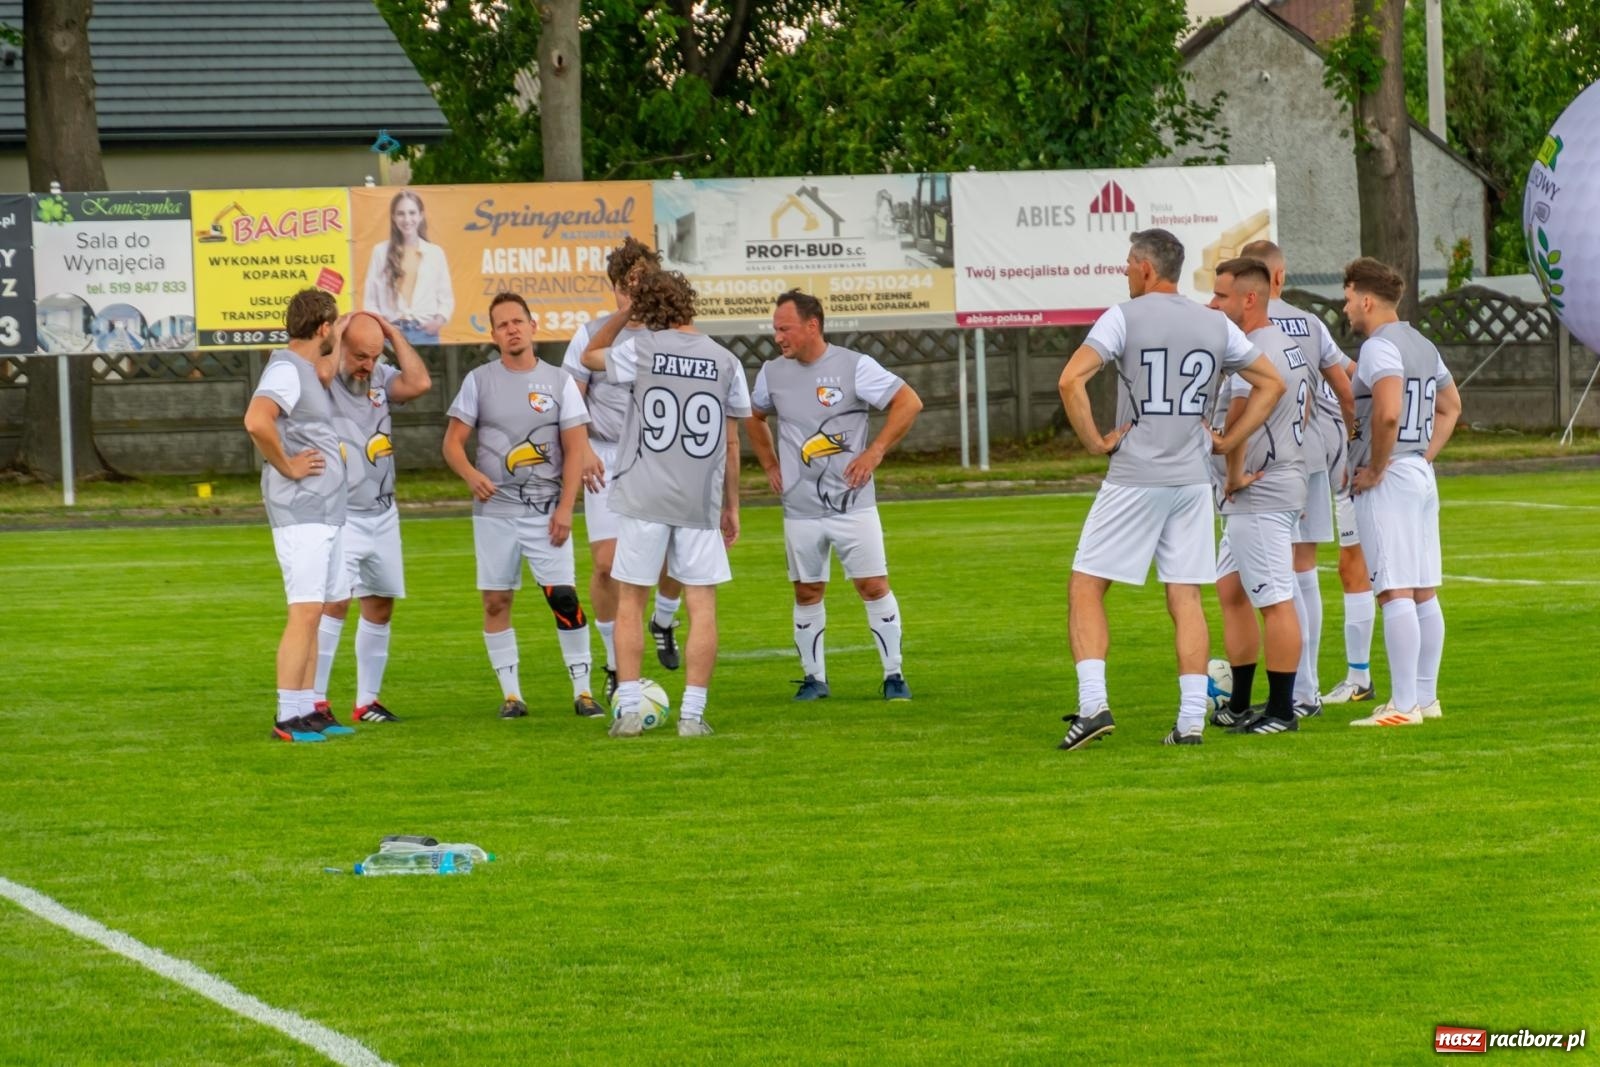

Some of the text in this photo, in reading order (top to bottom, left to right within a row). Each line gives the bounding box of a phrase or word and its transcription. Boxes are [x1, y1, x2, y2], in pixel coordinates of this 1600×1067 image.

[81, 197, 183, 219] Koniczynka
[1016, 204, 1076, 227] ABIES
[233, 207, 343, 242] BAGER
[464, 196, 634, 238] Springendal
[76, 232, 150, 249] Sala do
[746, 243, 843, 259] PROFI-BUD
[63, 254, 165, 275] Wynajęcia
[208, 254, 335, 267] WYKONAM USŁUGI
[481, 246, 610, 275] AGENCJA PRA
[243, 269, 308, 280] KOPARKĄ
[965, 263, 1129, 280] Twój specjalista od drew
[86, 281, 187, 295] tel. 519 847 833
[482, 275, 616, 296] ZAGRANICZN
[829, 273, 935, 292] 507510244
[250, 295, 293, 306] USŁUG
[724, 295, 777, 305] BUDOWLA
[830, 291, 912, 302] ROBOTY ZIEMNE
[830, 300, 930, 312] USŁUGI KOPARKAMI
[966, 312, 1043, 326] abies-polska.pl
[233, 330, 290, 343] 880 55
[652, 353, 718, 381] PAWEŁ
[1140, 348, 1216, 416] 12
[642, 386, 723, 459] 99
